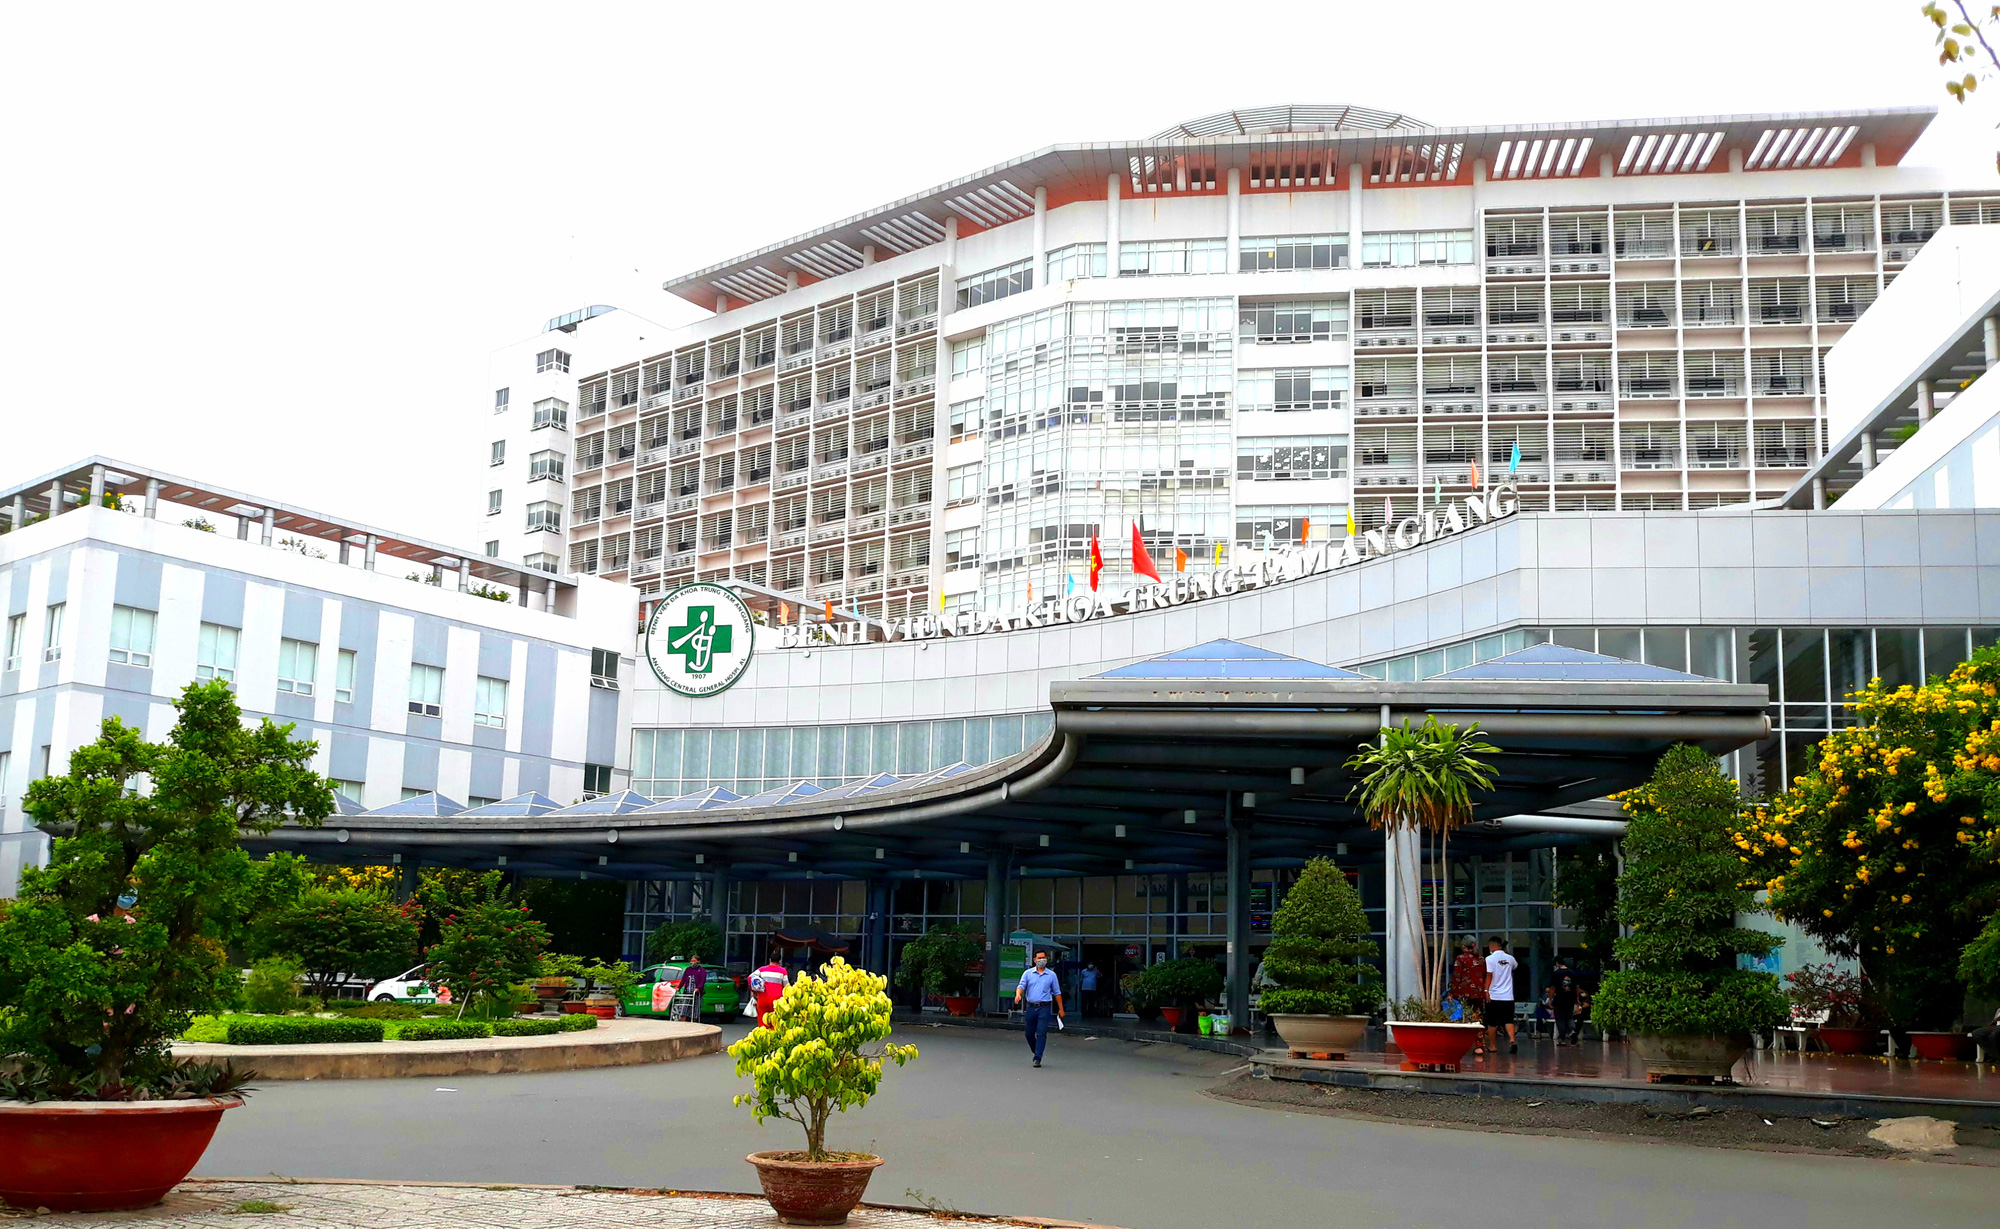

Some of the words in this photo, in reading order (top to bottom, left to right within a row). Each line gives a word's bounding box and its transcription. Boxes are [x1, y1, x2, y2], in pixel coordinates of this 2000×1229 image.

[680, 587, 698, 597] KHOA
[700, 586, 721, 595] TRUNG
[1018, 595, 1115, 628] KHOA
[1122, 566, 1243, 614] TRUNG
[670, 680, 697, 693] CENTRAL
[698, 680, 726, 693] GENERAL
